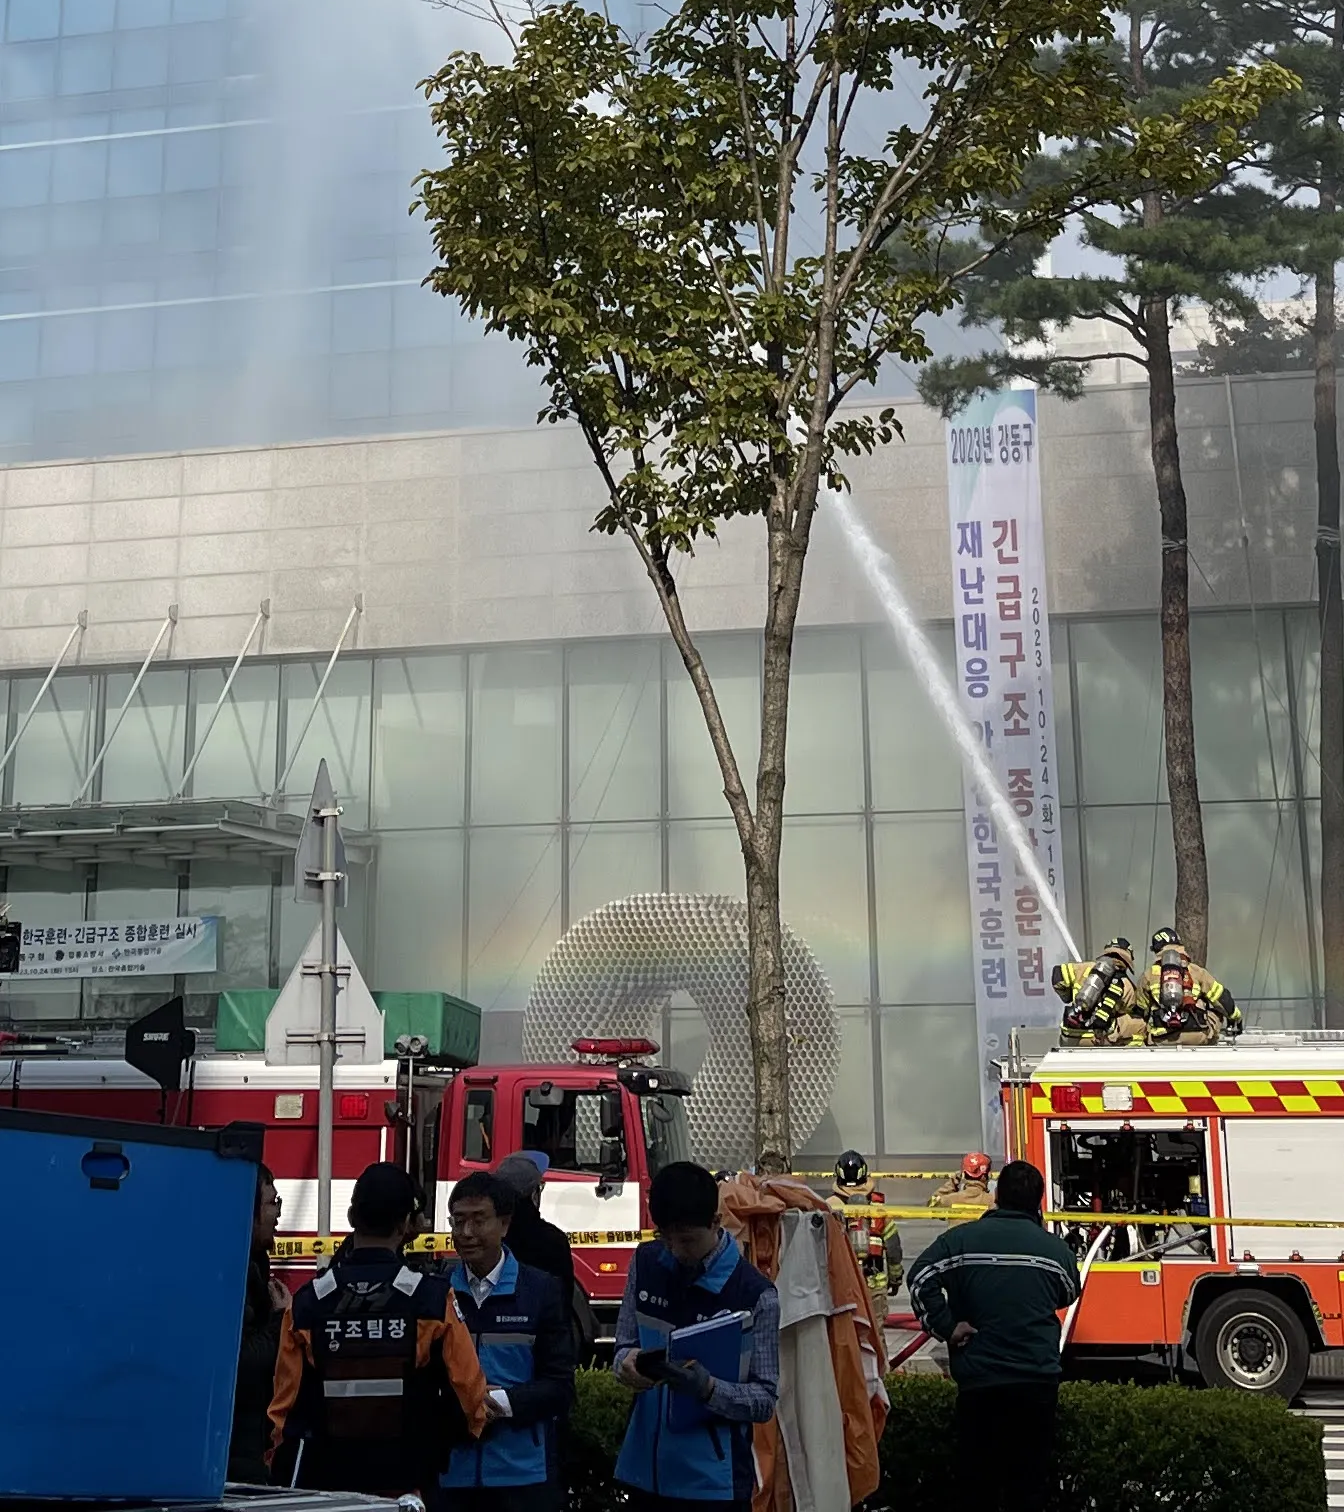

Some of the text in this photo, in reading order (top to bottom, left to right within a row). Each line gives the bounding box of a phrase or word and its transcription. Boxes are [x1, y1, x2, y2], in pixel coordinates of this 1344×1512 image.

[950, 423, 1033, 465] 2023년 강동구
[956, 520, 990, 699] 재난대응
[992, 519, 1045, 997] 긴급구조 종훈련
[124, 923, 170, 943] 종합훈련
[175, 923, 197, 940] 실시
[324, 1318, 407, 1339] 구조팀장
